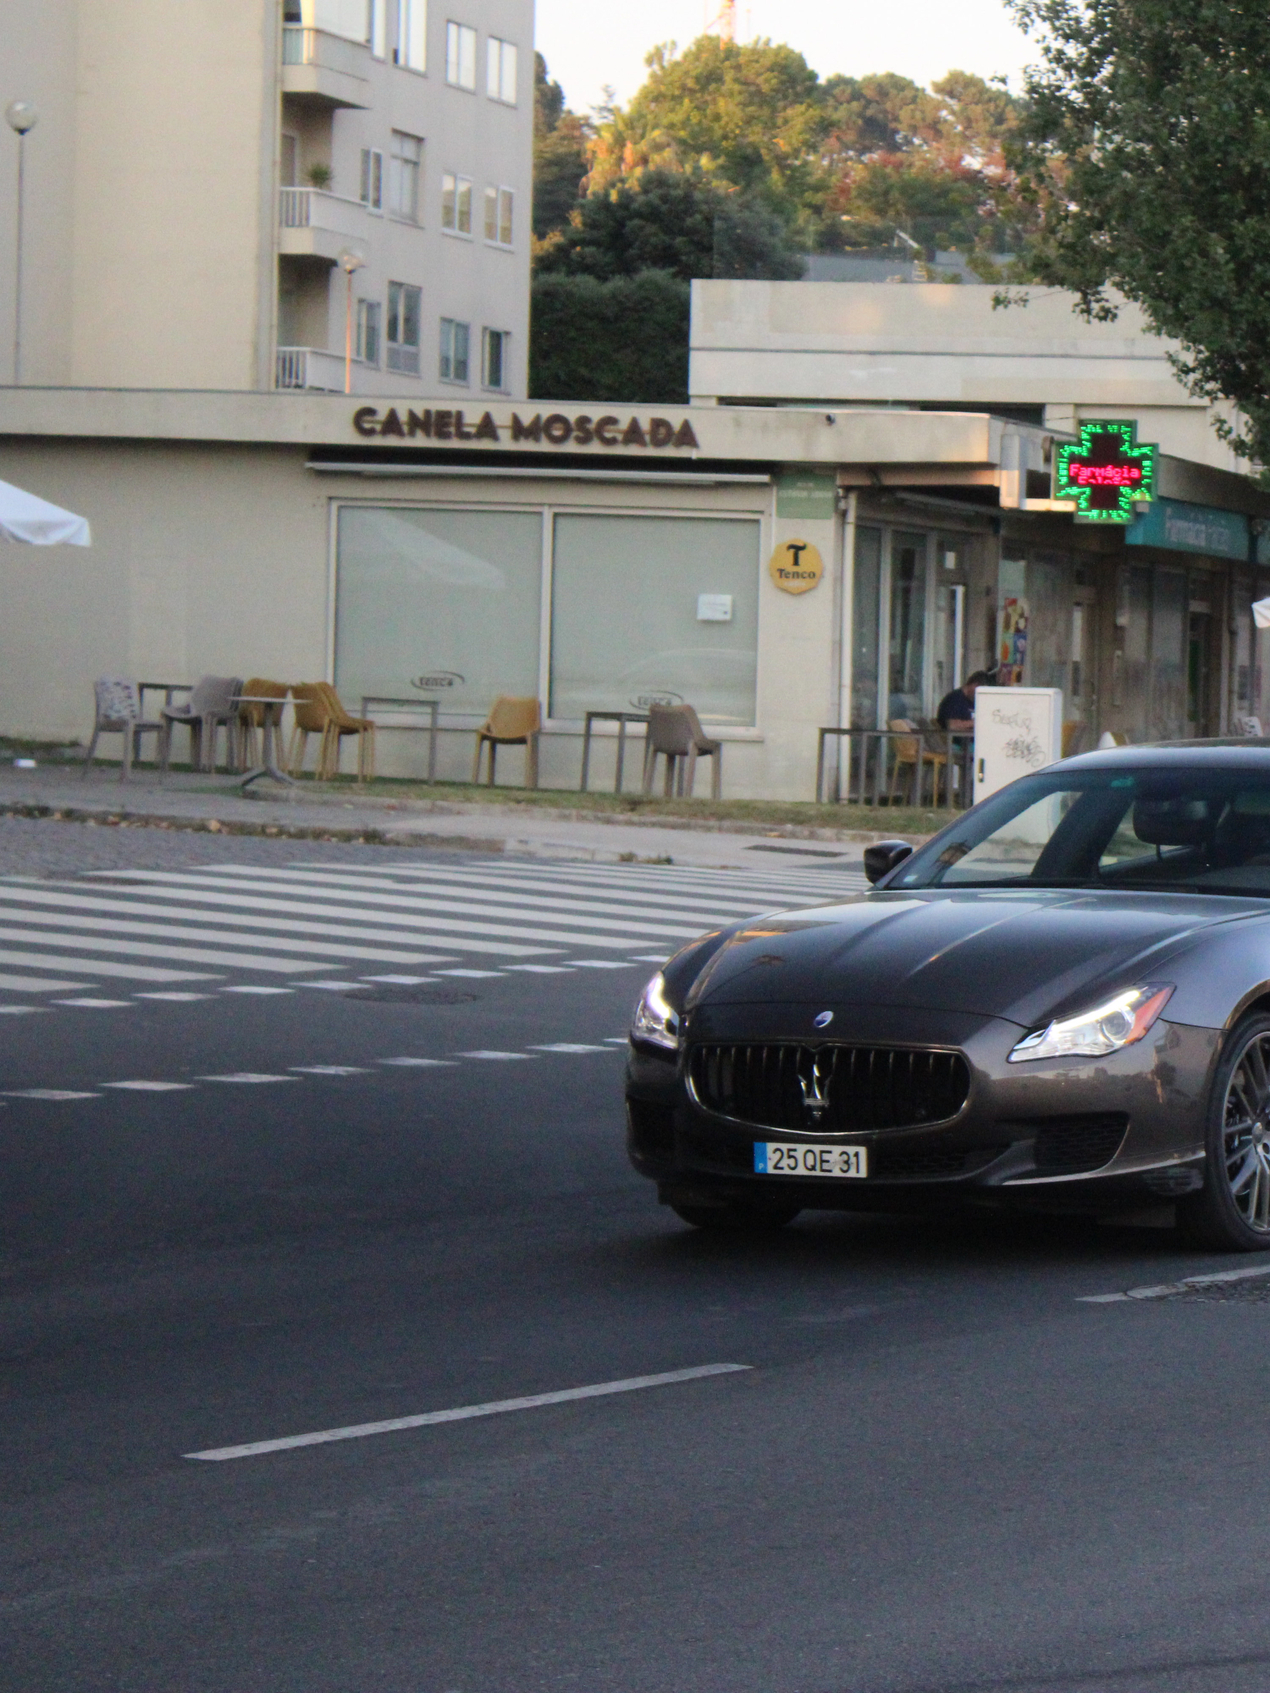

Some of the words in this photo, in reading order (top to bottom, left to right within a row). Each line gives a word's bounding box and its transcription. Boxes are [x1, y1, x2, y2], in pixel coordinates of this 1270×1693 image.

[353, 406, 499, 442] CANELA
[510, 412, 700, 449] MOSCADA
[1069, 464, 1141, 479] Farmácia
[777, 568, 816, 579] Tenco
[772, 1147, 798, 1171] 25
[803, 1149, 834, 1173] QE
[839, 1151, 860, 1174] 31
